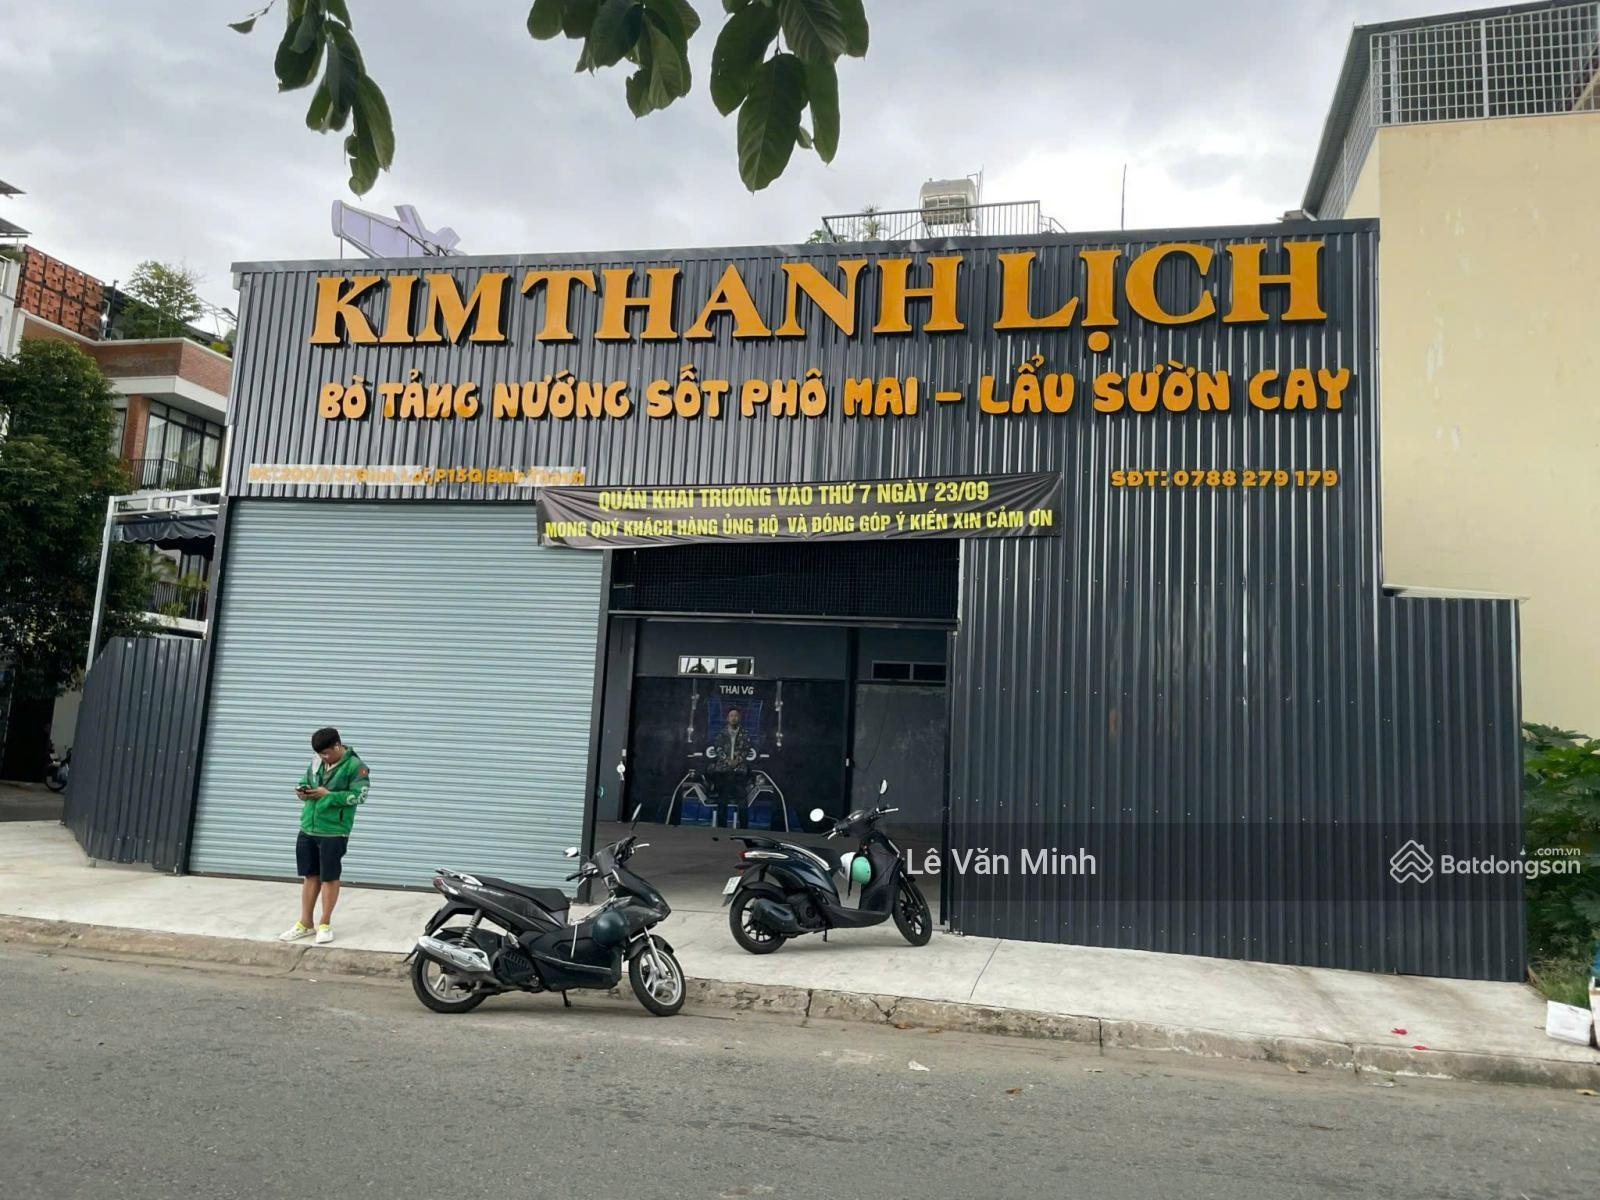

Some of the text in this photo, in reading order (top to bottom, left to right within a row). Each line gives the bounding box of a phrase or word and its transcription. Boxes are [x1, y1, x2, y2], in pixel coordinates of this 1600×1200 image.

[310, 240, 1328, 353] KIM THANH LỊCH
[319, 374, 366, 418] BÒ
[493, 369, 632, 418] NƯỚNG
[646, 363, 729, 417] SỐT
[741, 368, 827, 416] PHÔ
[843, 376, 918, 416] MAI
[979, 353, 1075, 414] LẨU
[1092, 359, 1230, 413] SƯỜN
[1248, 367, 1351, 411] CAY
[1111, 469, 1338, 488] SĐT: 0788 279 179
[598, 480, 989, 512] QUÁN KHAI TRƯƠNG VÀO THỨ 7 NGÀY 23/09
[545, 505, 1053, 539] MONG QUÝ KHÁCH HÀNG ỦNG HỘ VÀ ĐÓNG GÓP Ý KIẾN XIN CẢM ƠN
